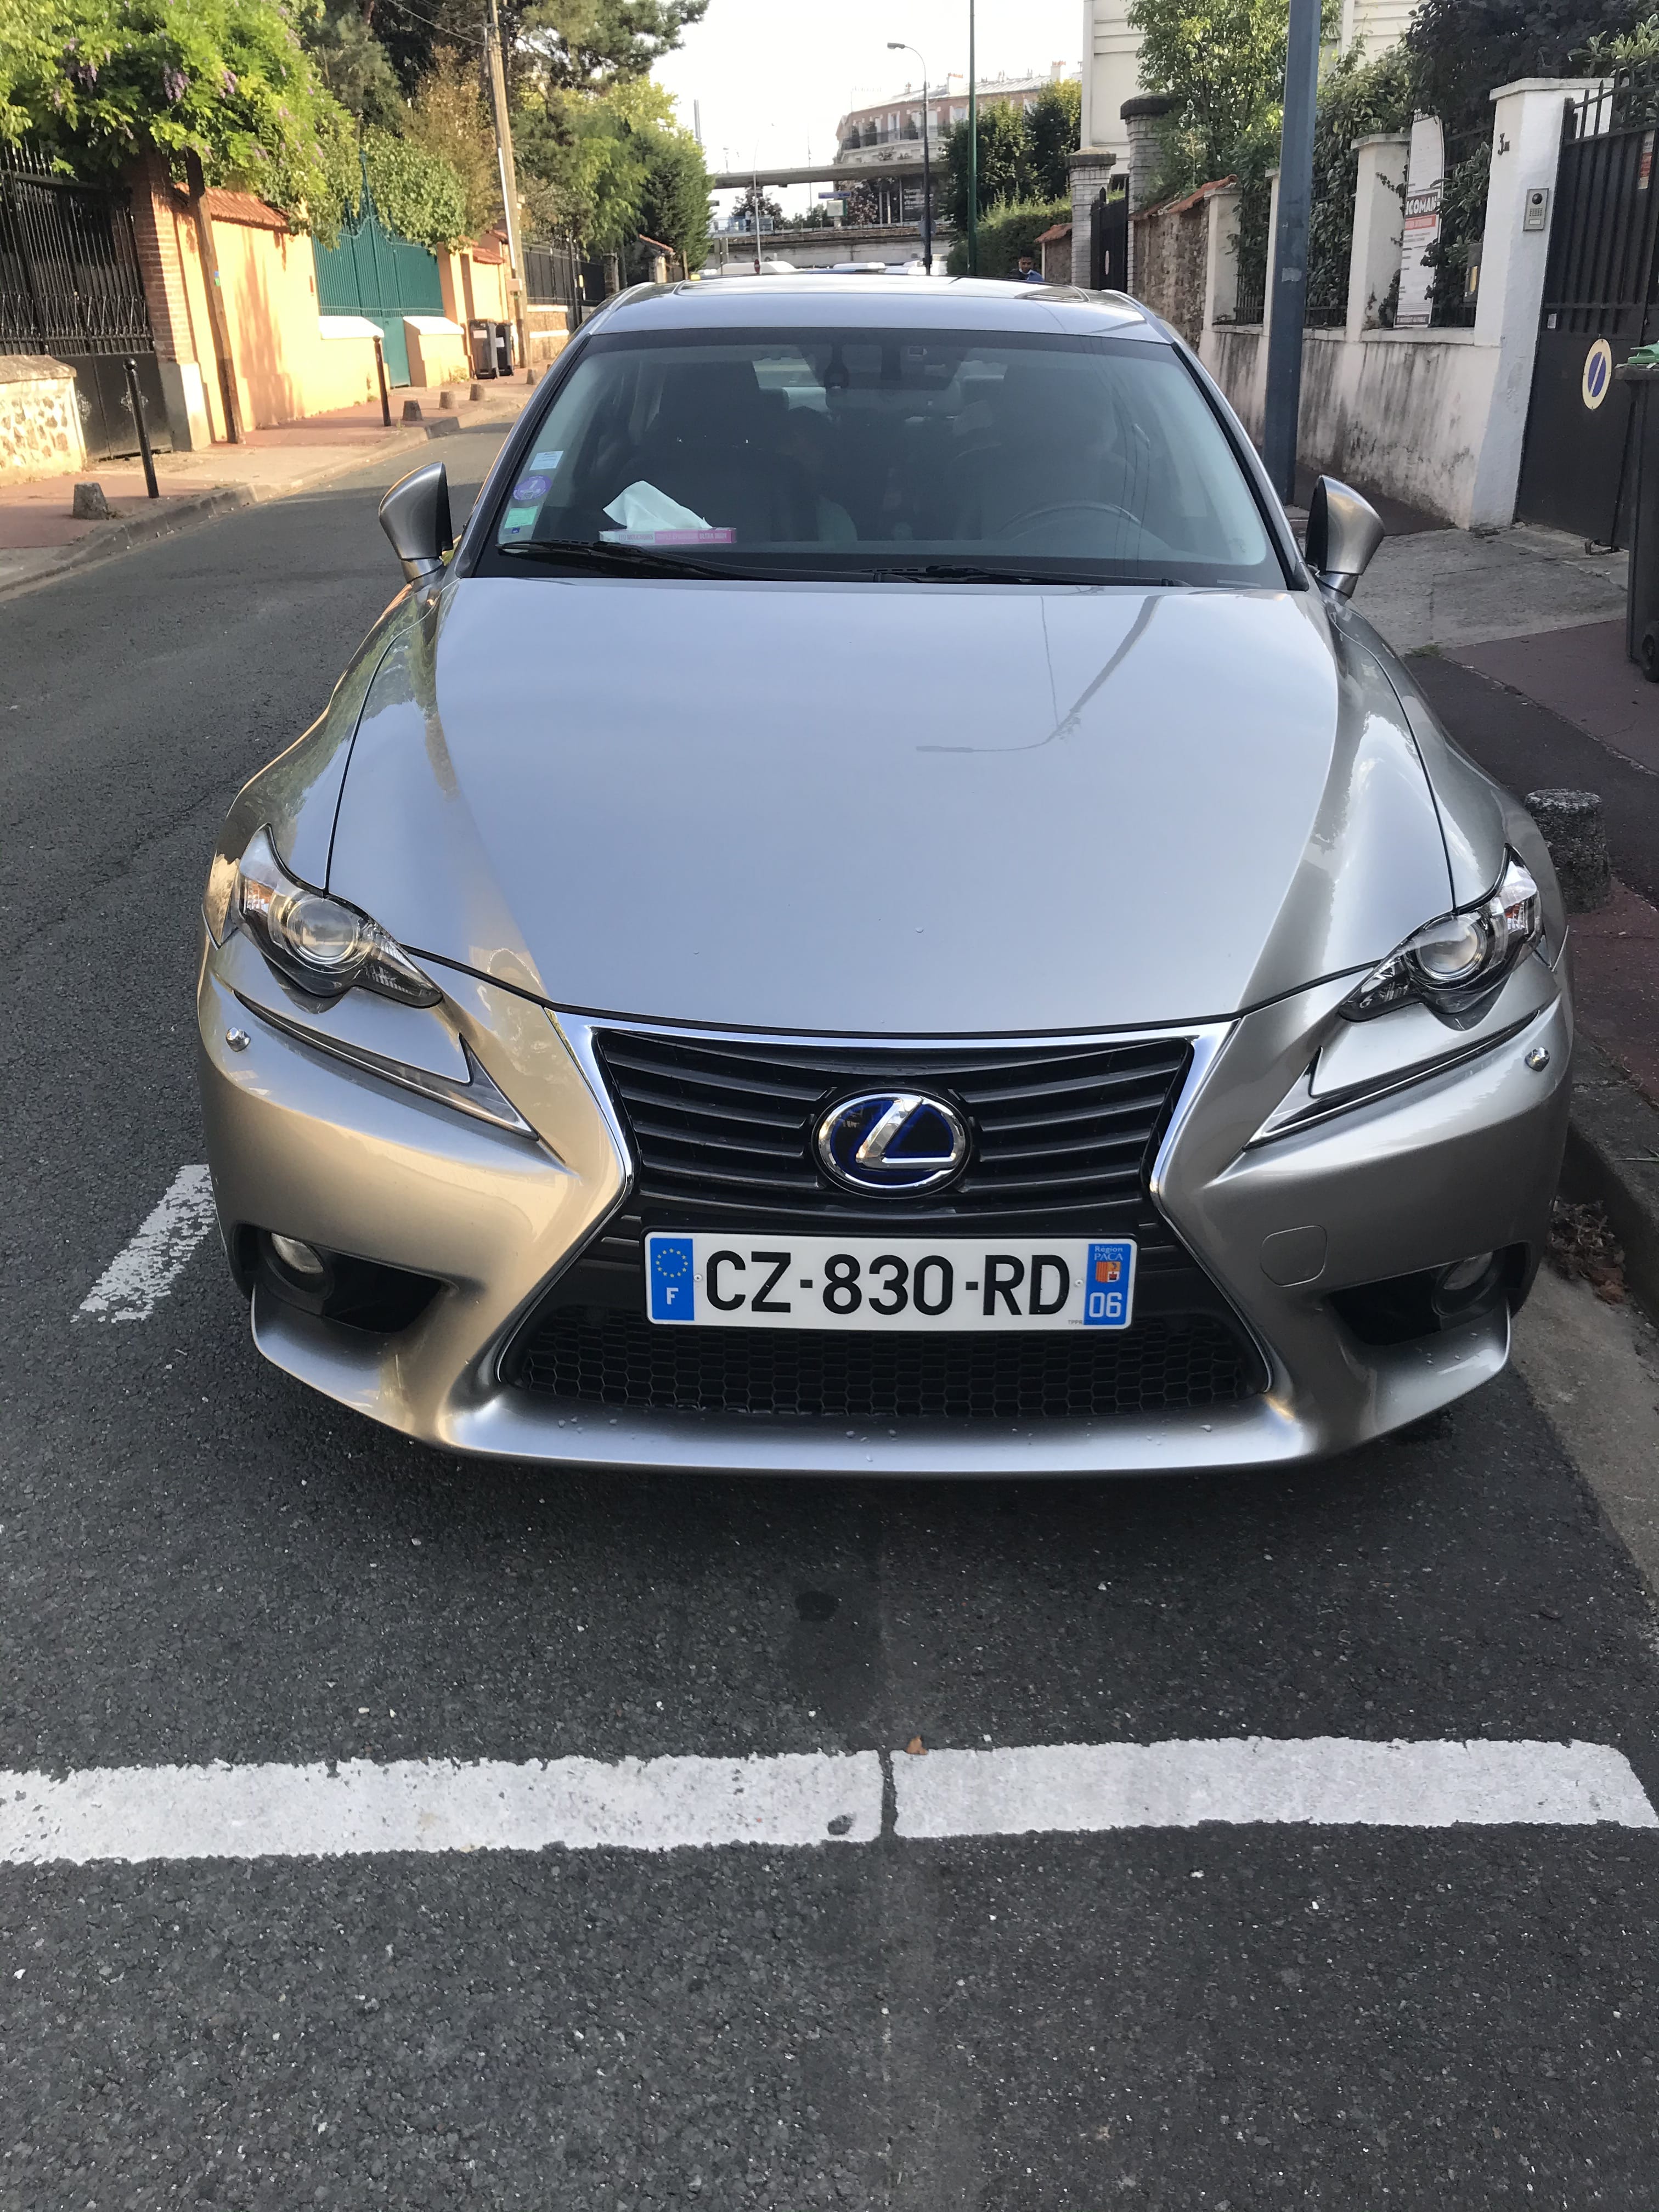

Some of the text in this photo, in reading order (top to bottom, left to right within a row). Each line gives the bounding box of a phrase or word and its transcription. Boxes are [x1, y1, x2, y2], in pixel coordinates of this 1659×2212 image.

[666, 1286, 679, 1305] F
[706, 1250, 1070, 1316] CZ-830-RD
[1088, 1291, 1122, 1318] 06
